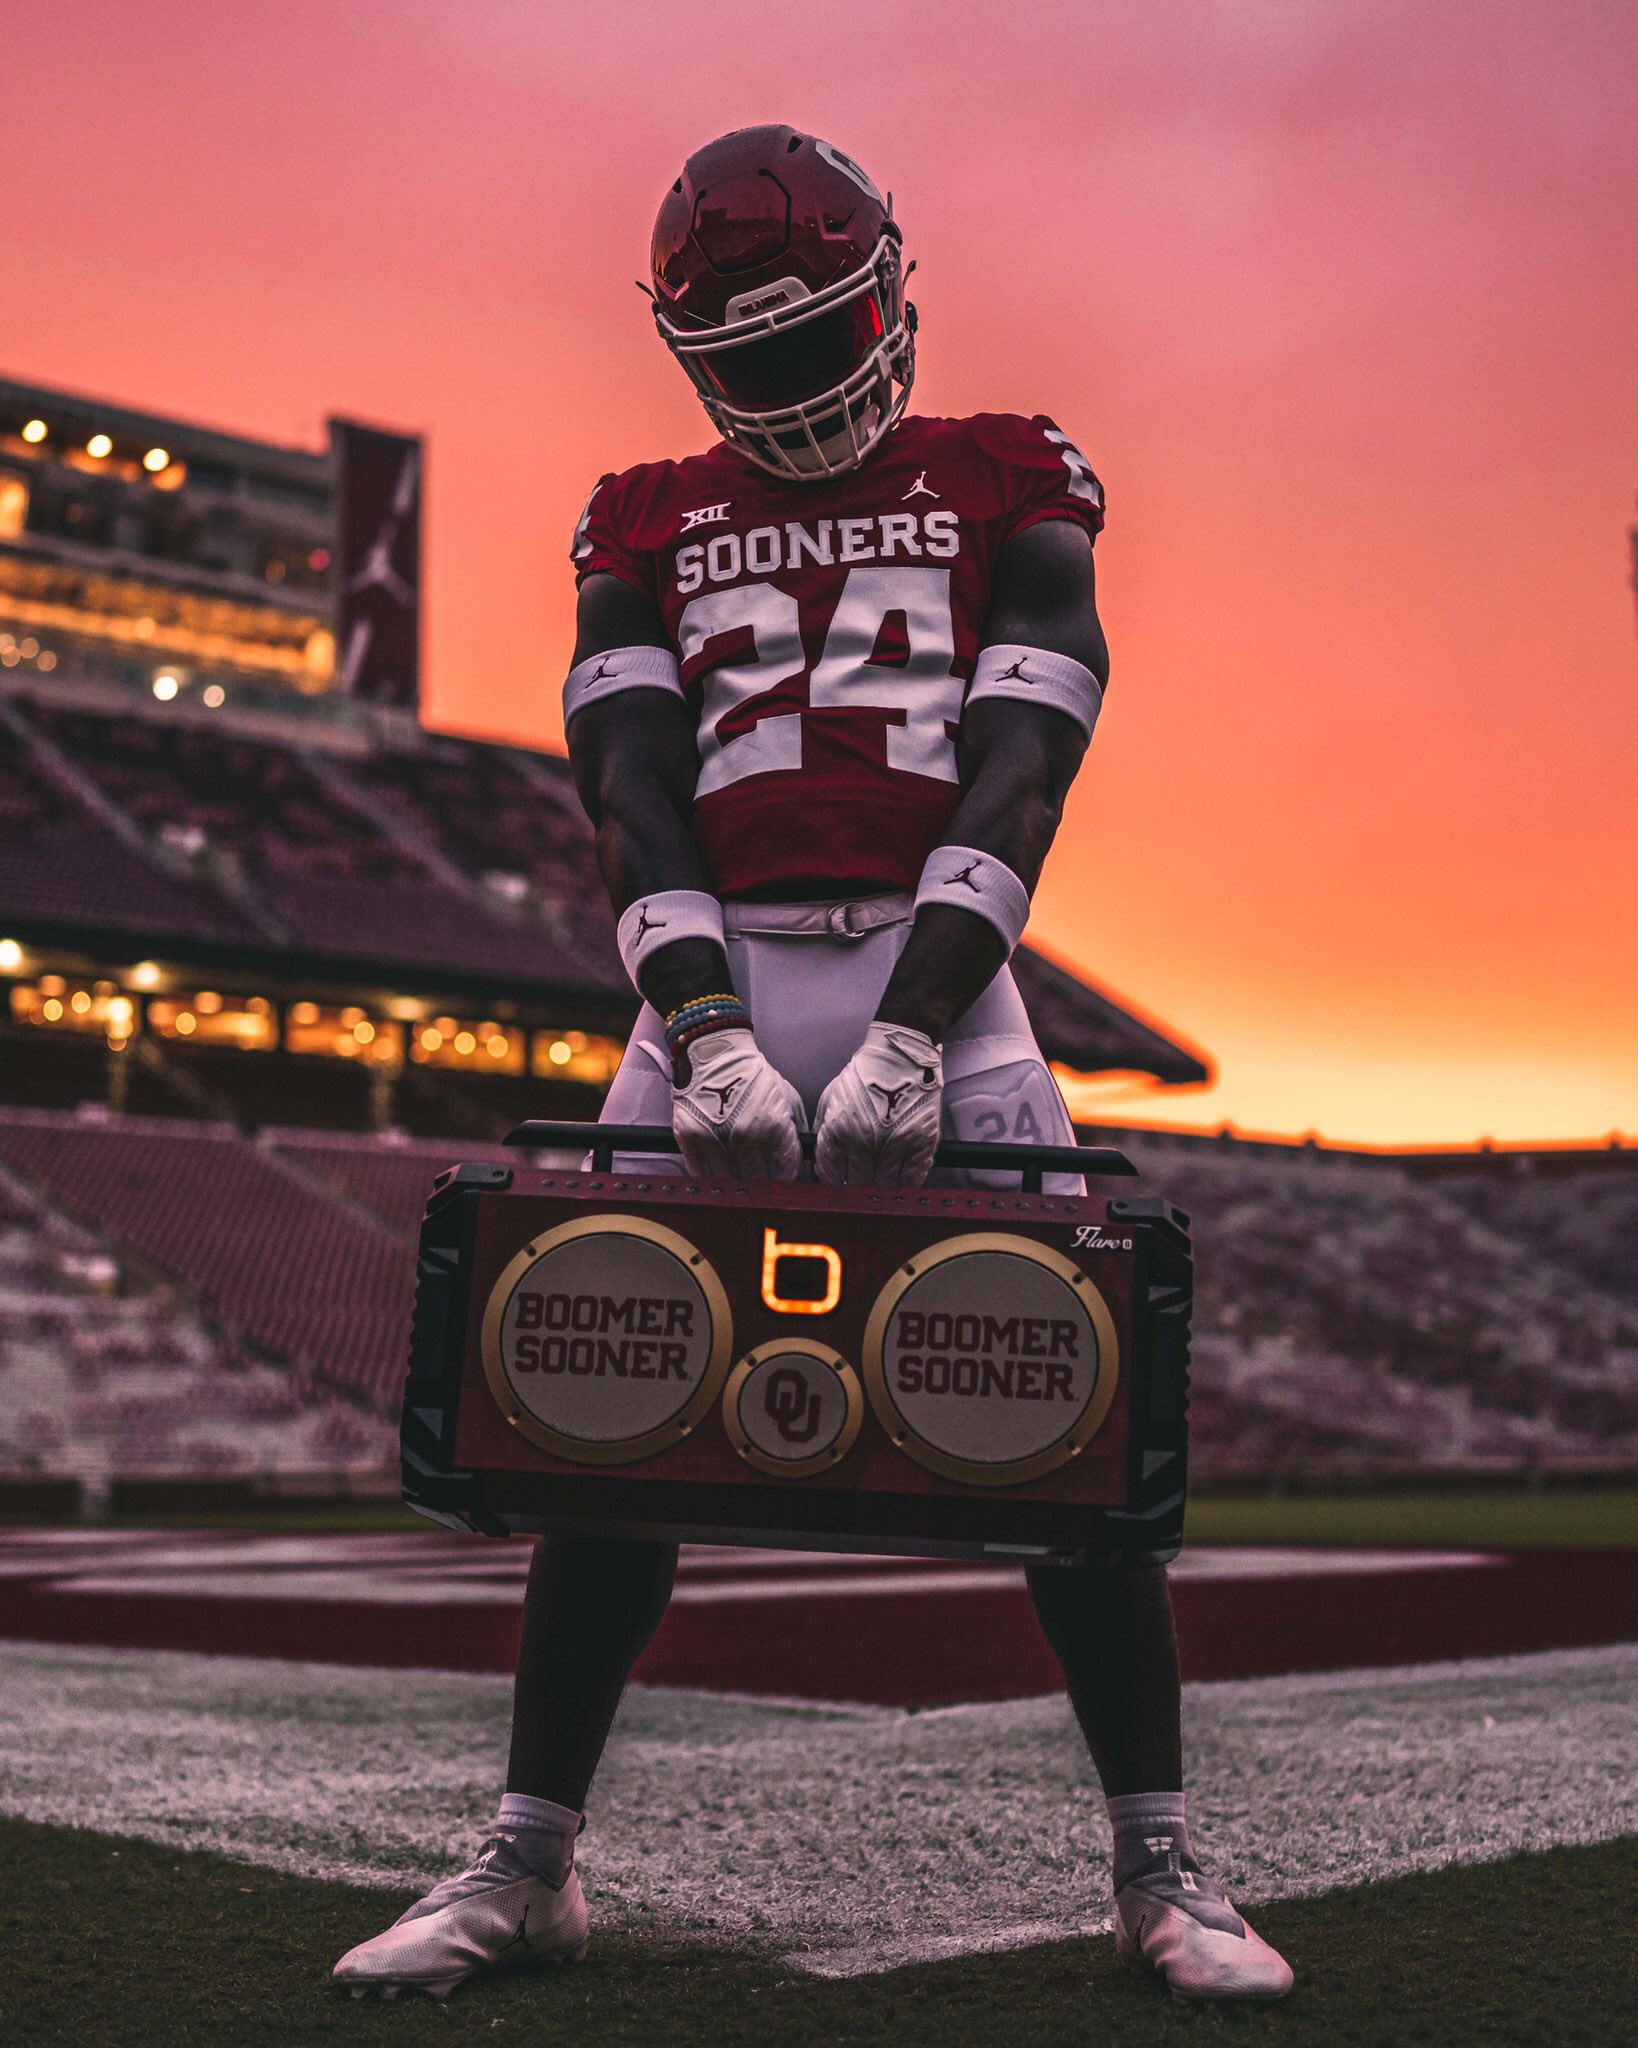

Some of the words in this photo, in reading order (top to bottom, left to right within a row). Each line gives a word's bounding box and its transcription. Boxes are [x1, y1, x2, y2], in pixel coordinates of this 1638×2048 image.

[680, 501, 732, 533] XII
[675, 510, 960, 594] SOONERS
[678, 567, 967, 801] 24
[1070, 1225, 1121, 1249] Flare
[515, 1292, 694, 1338] BOOMER
[897, 1311, 1079, 1358] BOOMER
[764, 1369, 822, 1443] OU
